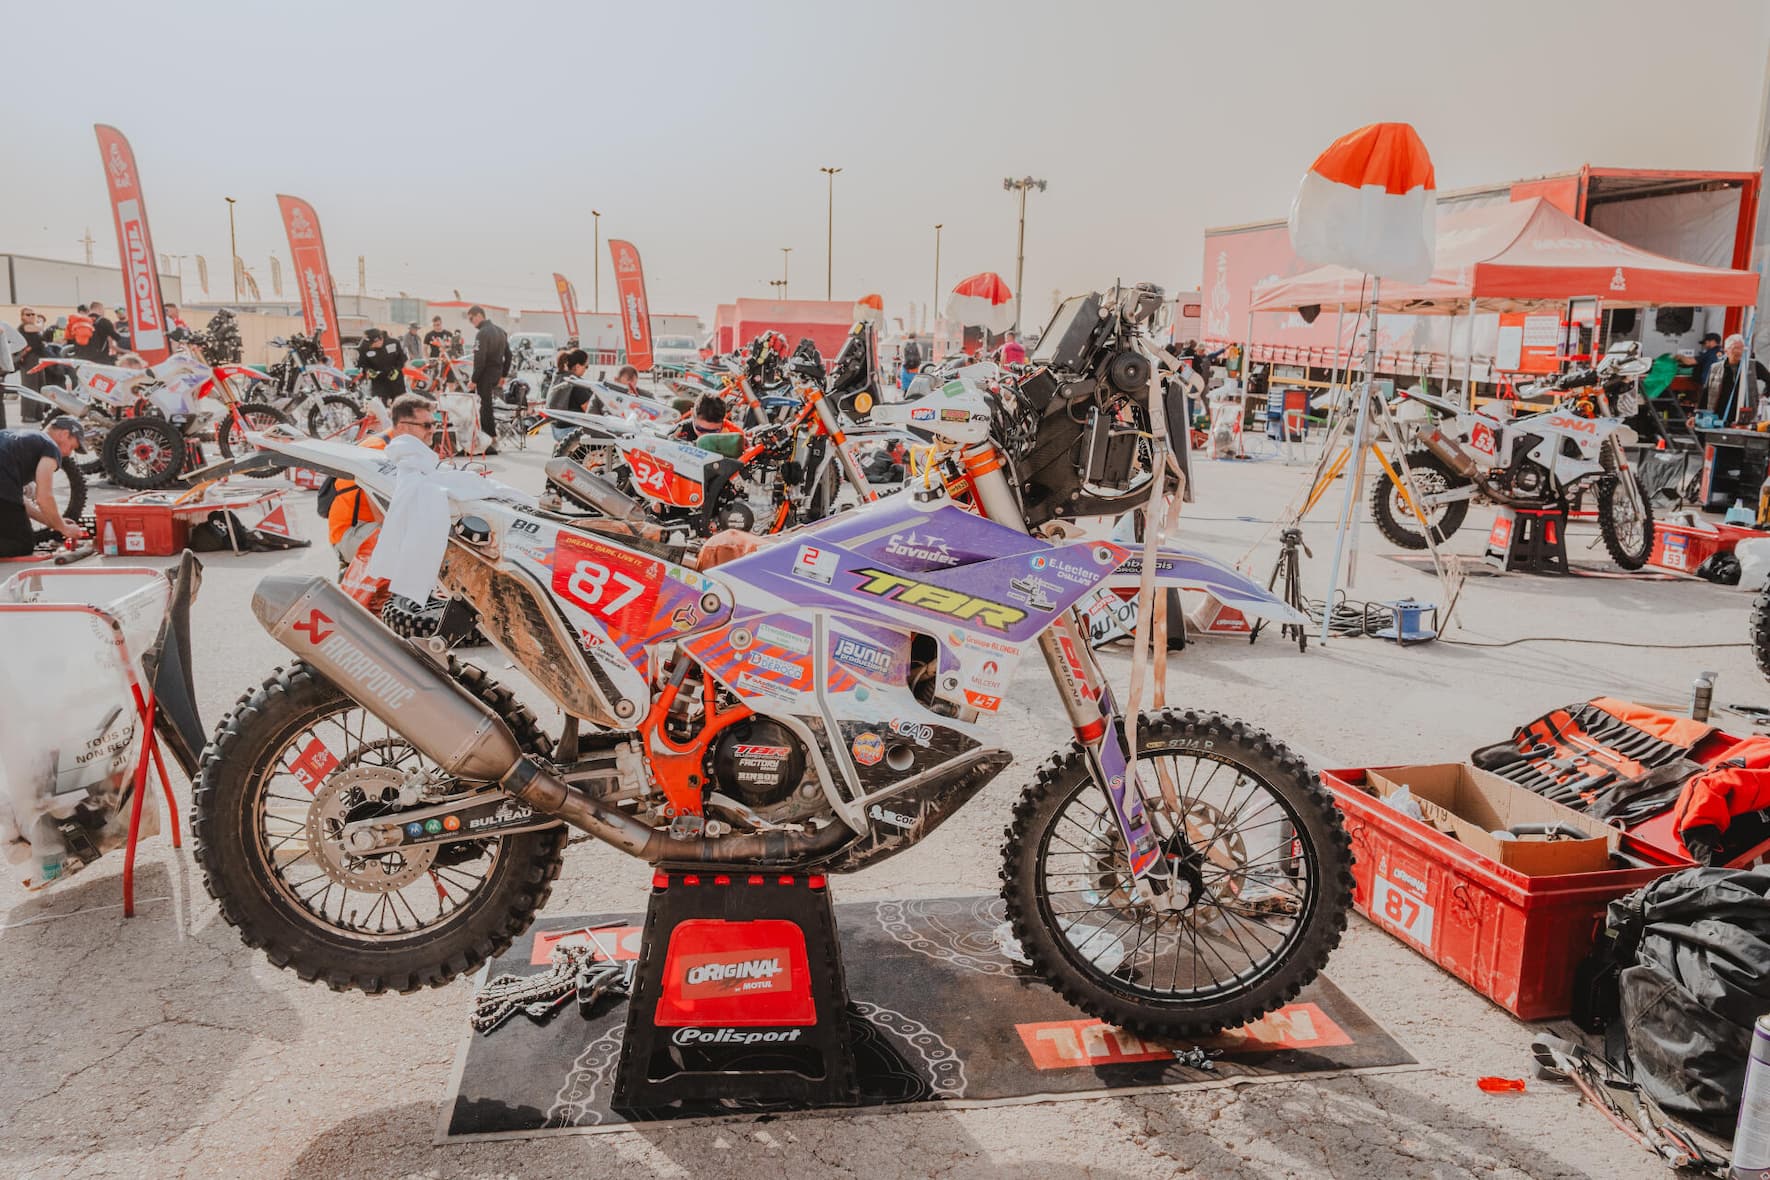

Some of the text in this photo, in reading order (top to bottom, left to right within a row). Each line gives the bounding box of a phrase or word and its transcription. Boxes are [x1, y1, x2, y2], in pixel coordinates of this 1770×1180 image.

[128, 225, 156, 326] MOTUL
[636, 463, 665, 490] 34
[566, 537, 594, 549] DREAM.
[617, 552, 634, 564] LIVE
[803, 547, 819, 566] 2
[1049, 558, 1100, 581] E.Leclerc
[568, 560, 645, 616] 87
[86, 731, 120, 749] TOUS
[76, 750, 104, 764] NON
[731, 744, 792, 756] TBR
[739, 758, 780, 767] FACTORY
[470, 809, 532, 828] BULTEAU
[1385, 888, 1420, 929] 87
[742, 980, 773, 990] MOTUL
[675, 1027, 801, 1045] Polisport
